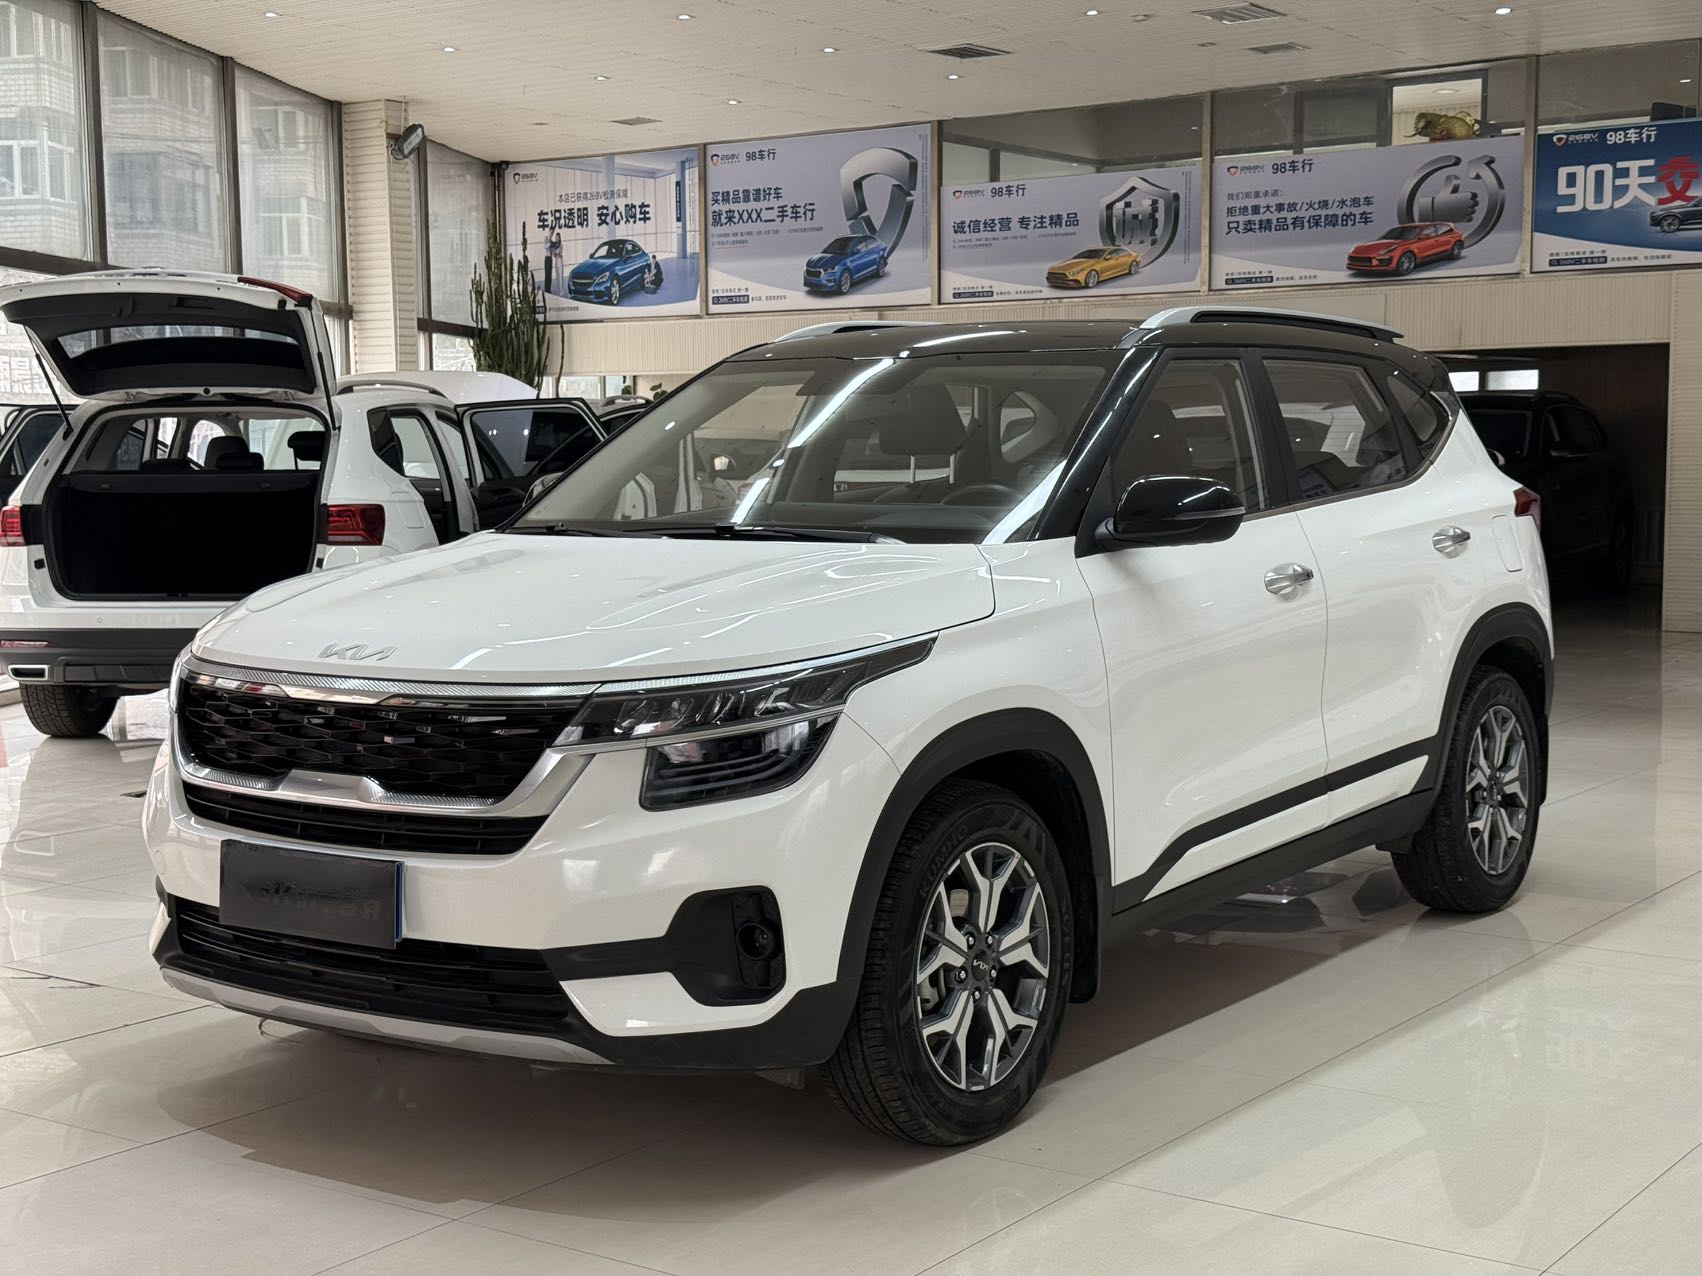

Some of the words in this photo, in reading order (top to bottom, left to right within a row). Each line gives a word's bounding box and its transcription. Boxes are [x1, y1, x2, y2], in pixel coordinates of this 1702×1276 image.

[1606, 127, 1657, 144] 98车行
[745, 148, 777, 162] 98车行
[1272, 158, 1314, 175] 98车行
[711, 186, 783, 206] 买精品靠谱好车
[990, 184, 1027, 198] 98车行
[537, 206, 589, 231] 车况透明
[597, 202, 651, 227] 安心购车
[711, 202, 816, 227] 就来XXX二手车行
[1226, 196, 1375, 217] 拒绝重大事故/火烧/水泡车
[952, 217, 1012, 234] 诚信经营
[1017, 212, 1079, 230] 专注精品
[1225, 211, 1375, 235] 只卖精品有保障的车
